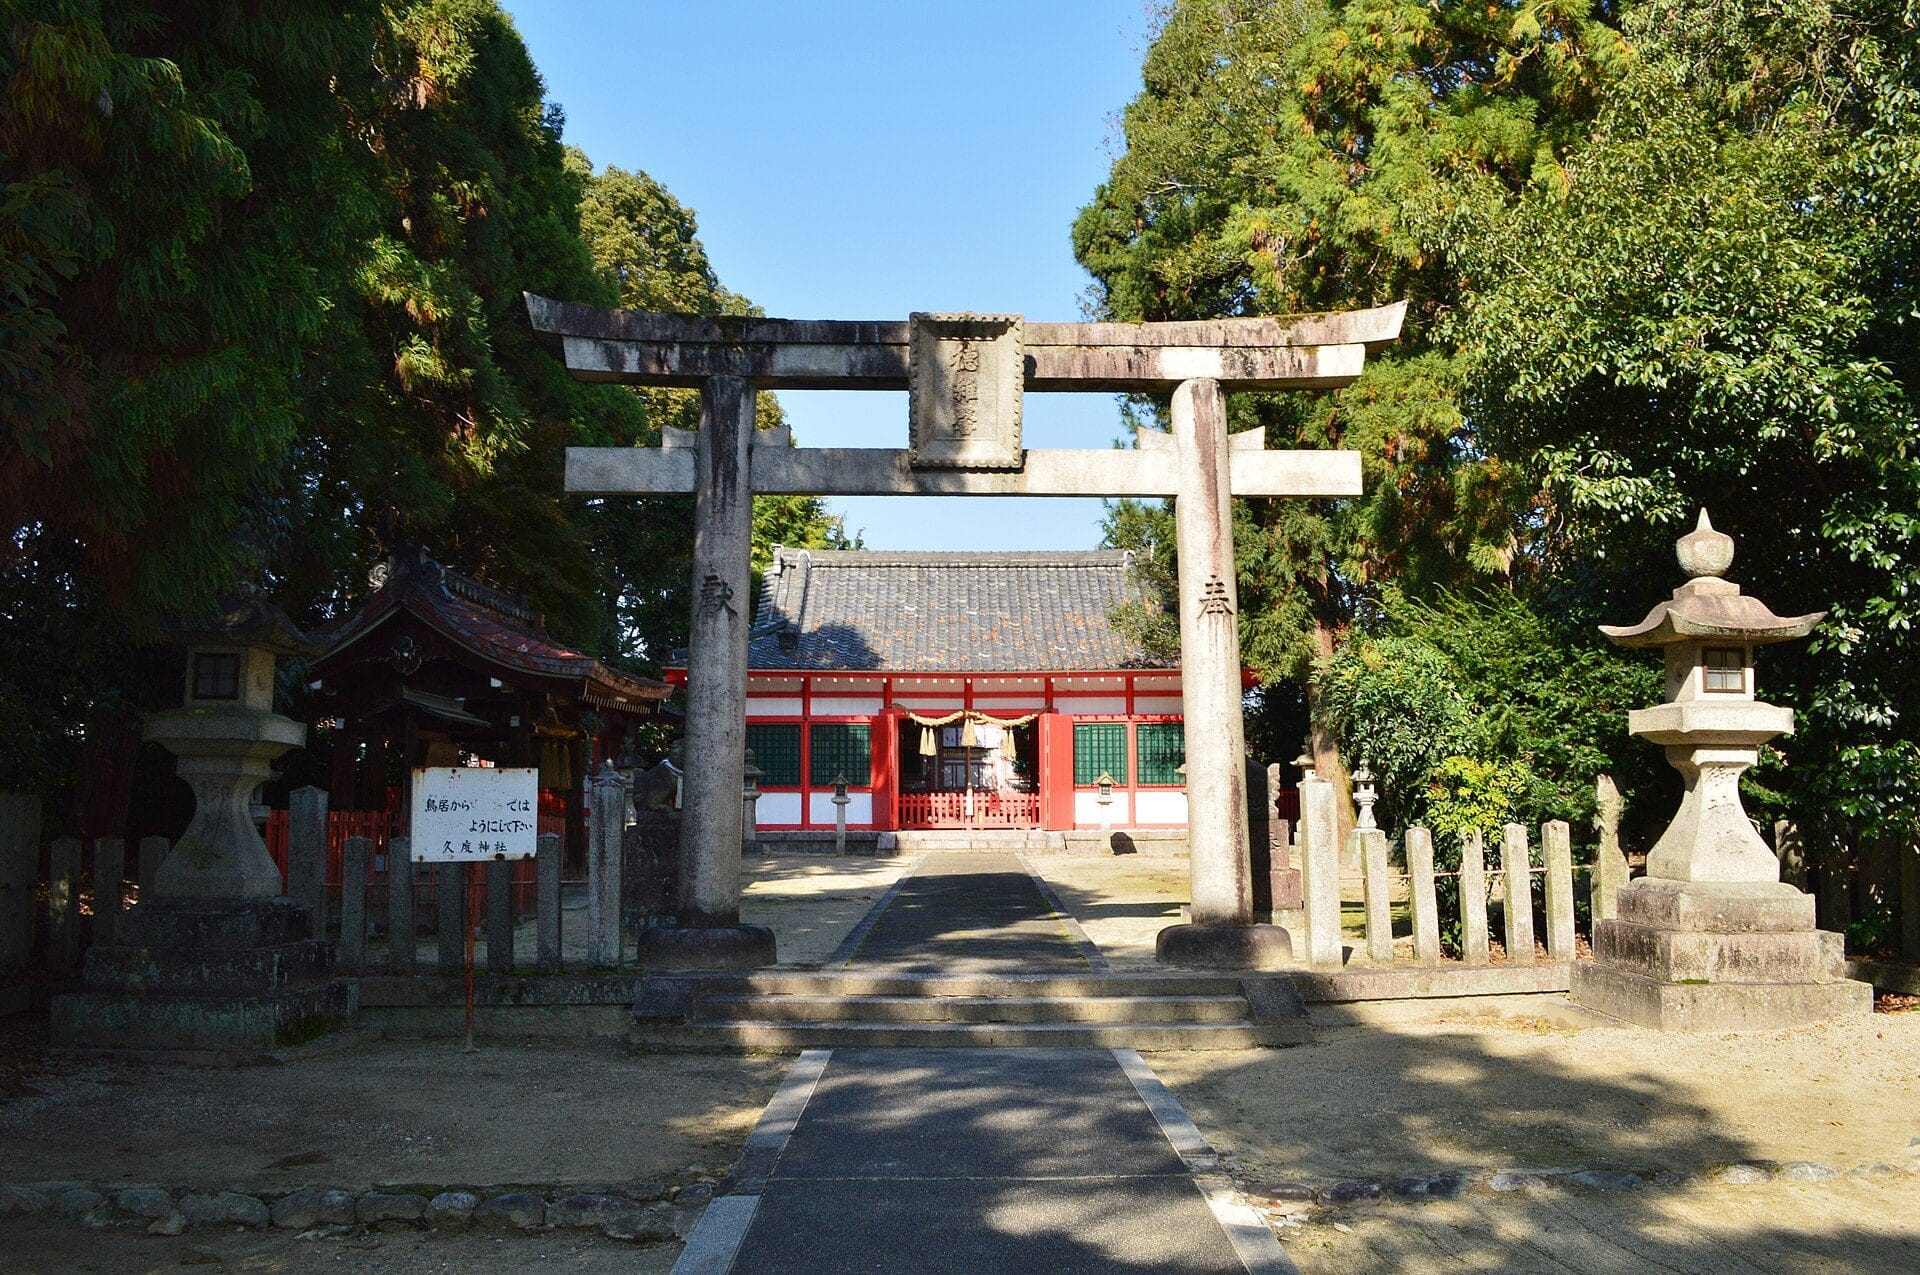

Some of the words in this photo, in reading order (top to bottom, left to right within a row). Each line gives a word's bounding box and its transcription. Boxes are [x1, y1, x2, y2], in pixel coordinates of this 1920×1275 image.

[1196, 574, 1235, 620] 奉
[425, 798, 470, 813] 鳥居から
[507, 798, 531, 812] では
[469, 819, 533, 833] ようにして下さい
[442, 840, 508, 854] 久度神社
